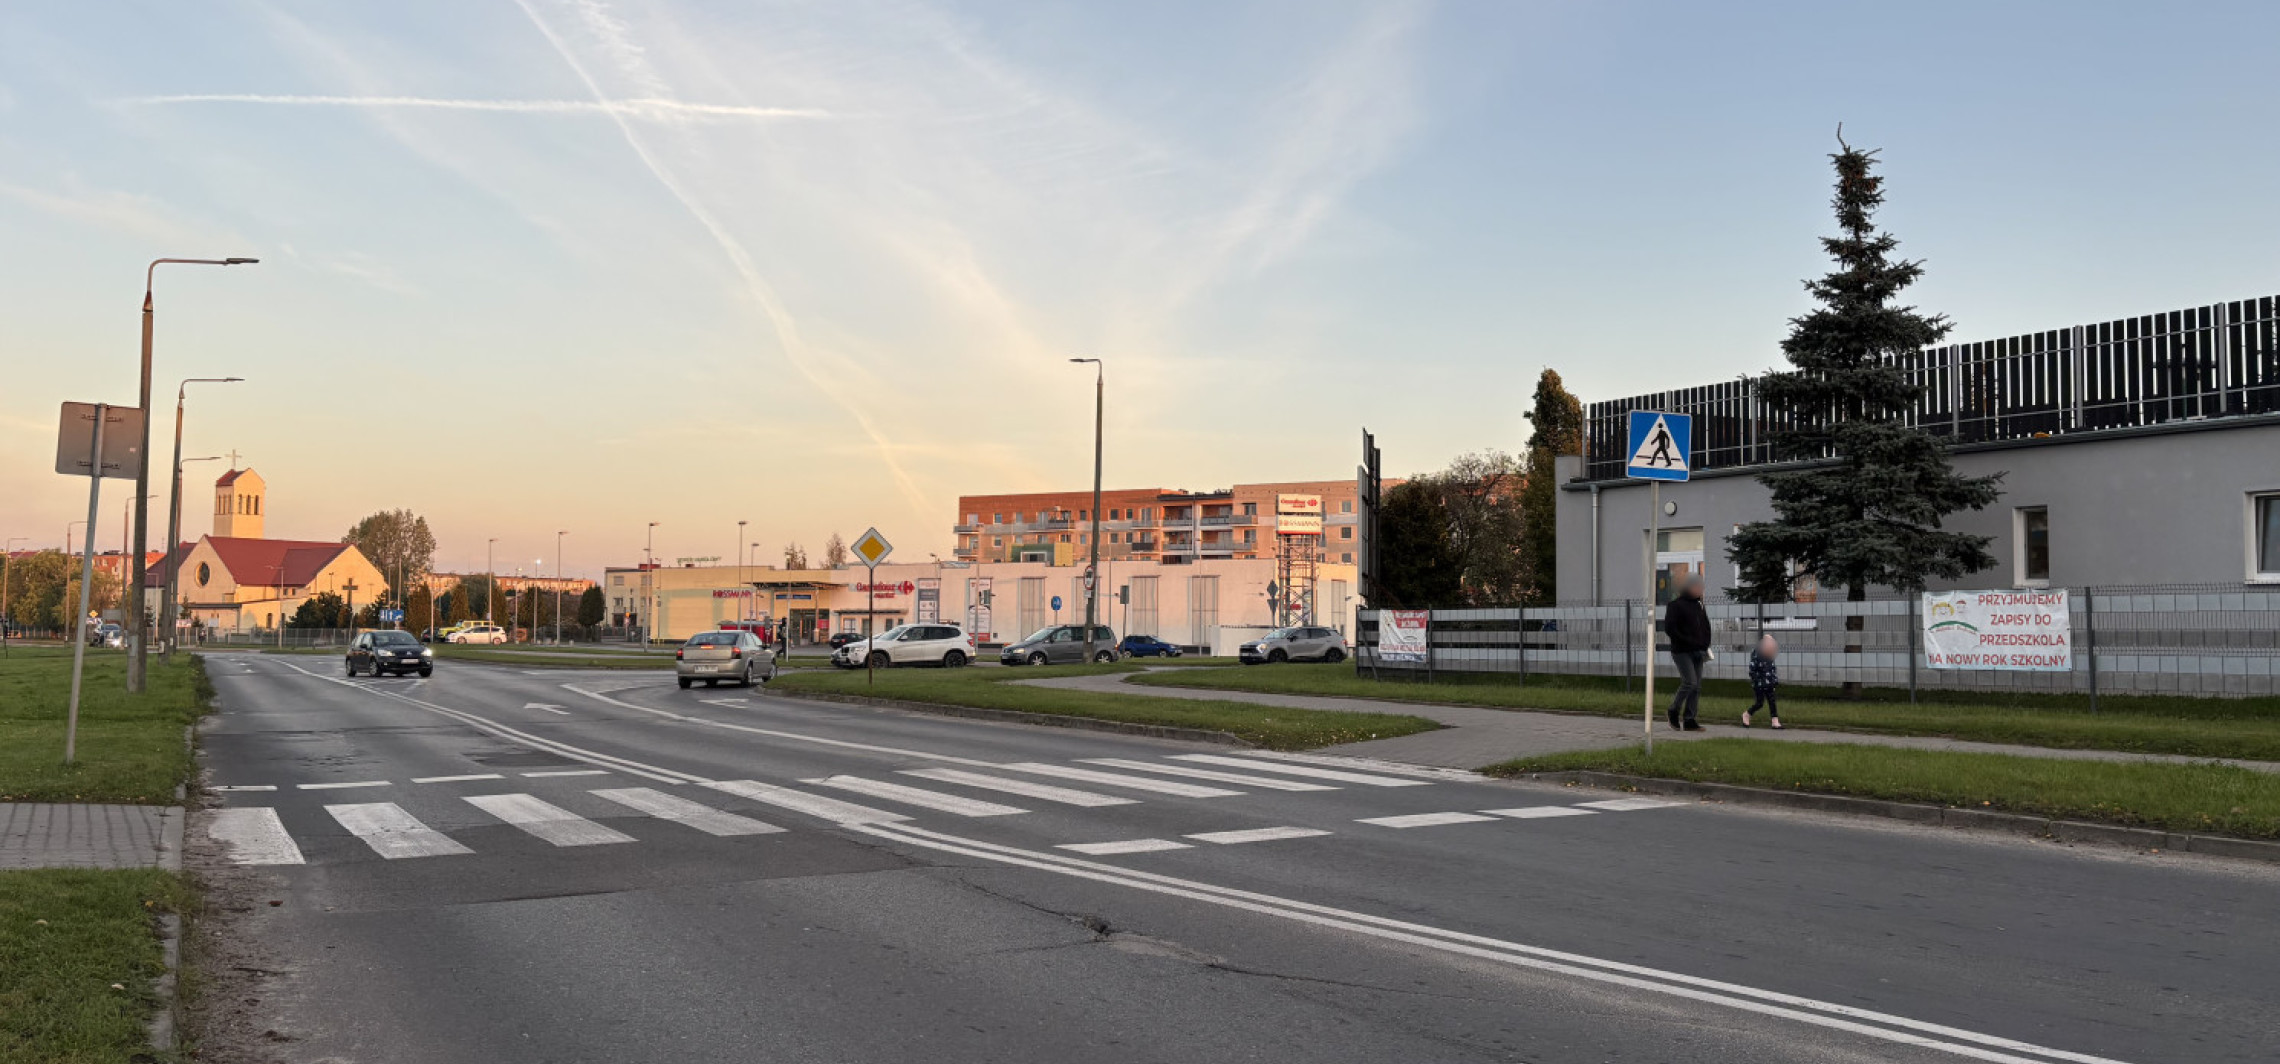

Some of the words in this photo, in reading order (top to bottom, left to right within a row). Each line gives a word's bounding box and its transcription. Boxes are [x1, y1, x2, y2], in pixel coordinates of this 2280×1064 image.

[856, 581, 896, 592] Carefour
[1978, 594, 2063, 605] PRZYJMUJEMY
[1990, 614, 2031, 625] ZAPISY
[2034, 614, 2051, 625] DO
[1979, 634, 2065, 646] PRZEDSZKOLA
[1928, 654, 1943, 664] NA
[1946, 654, 1980, 665] NOWY
[1982, 654, 2007, 665] ROK
[2011, 655, 2066, 666] SZKOLNY
